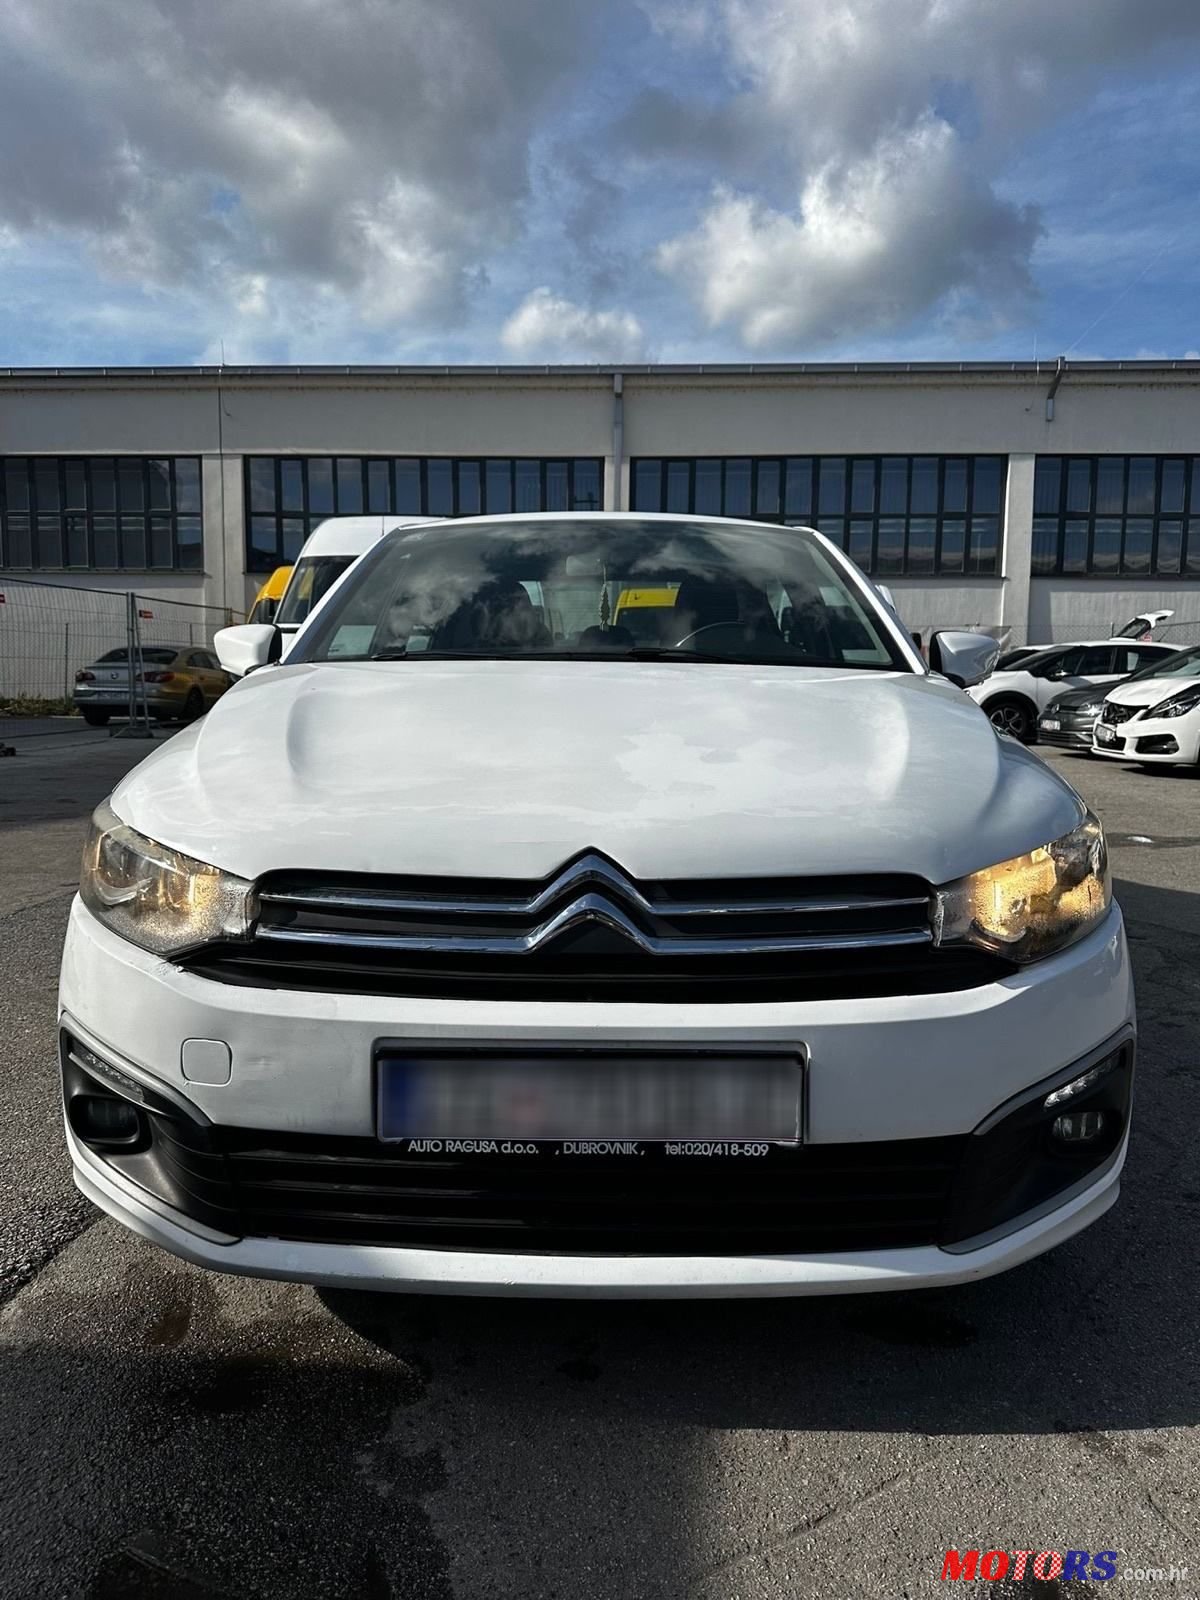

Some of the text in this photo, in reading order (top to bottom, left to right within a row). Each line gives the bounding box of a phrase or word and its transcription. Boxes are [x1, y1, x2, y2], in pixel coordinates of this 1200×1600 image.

[407, 1139, 443, 1153] AUTO
[445, 1139, 499, 1153] RAGUSA
[500, 1141, 539, 1154] d.o.o.
[664, 1142, 770, 1157] tel:020/418-509
